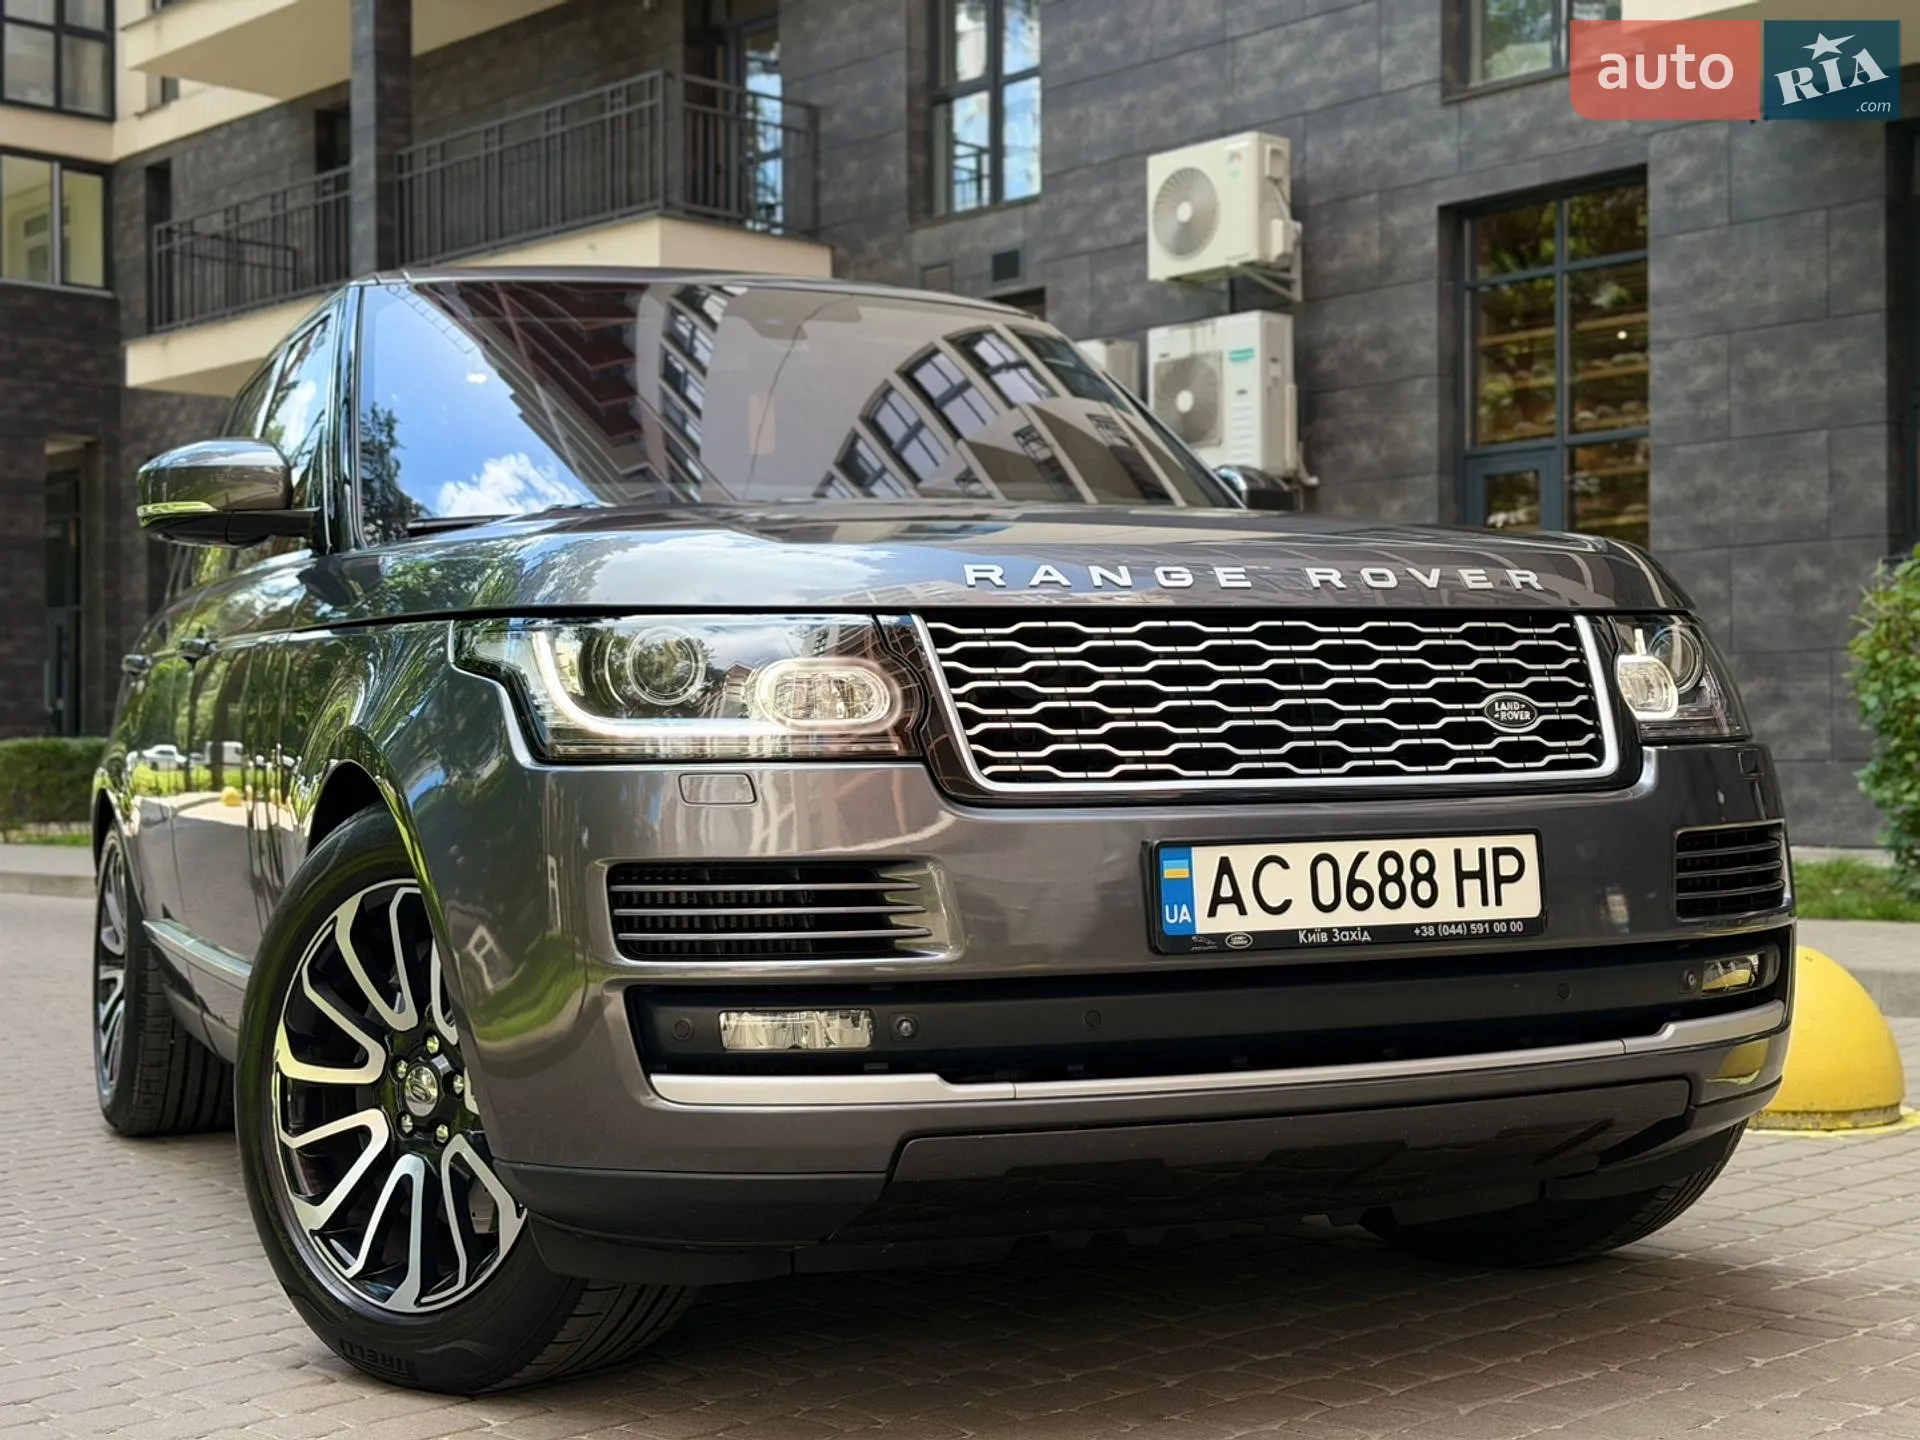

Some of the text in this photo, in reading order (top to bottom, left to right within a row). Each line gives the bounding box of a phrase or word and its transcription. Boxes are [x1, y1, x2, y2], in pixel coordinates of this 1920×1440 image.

[963, 563, 1544, 592] RANGE ROVER
[1207, 846, 1526, 919] AC 0688 HP
[1165, 904, 1191, 924] UA
[1298, 926, 1372, 944] Київ Захід
[1413, 920, 1524, 937] +38 (044) 591 00 00
